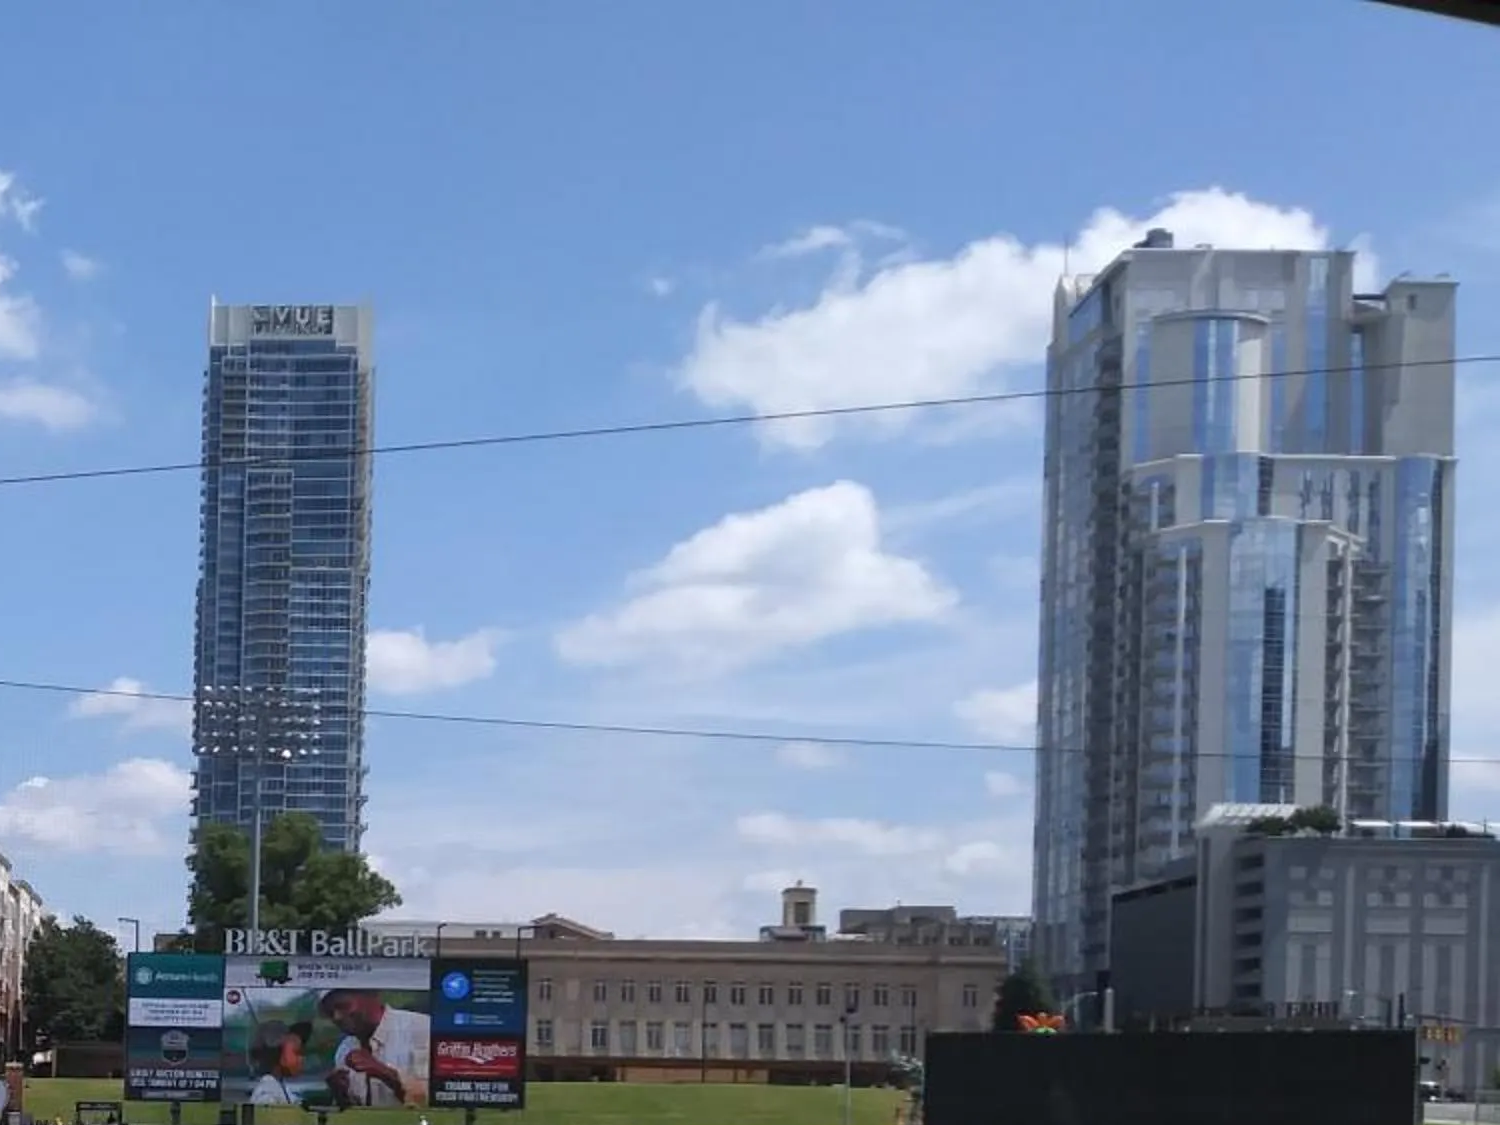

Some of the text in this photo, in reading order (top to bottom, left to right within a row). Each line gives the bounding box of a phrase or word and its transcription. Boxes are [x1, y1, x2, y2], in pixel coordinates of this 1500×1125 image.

[275, 307, 331, 324] VUE
[225, 926, 428, 957] BB&T BallPark
